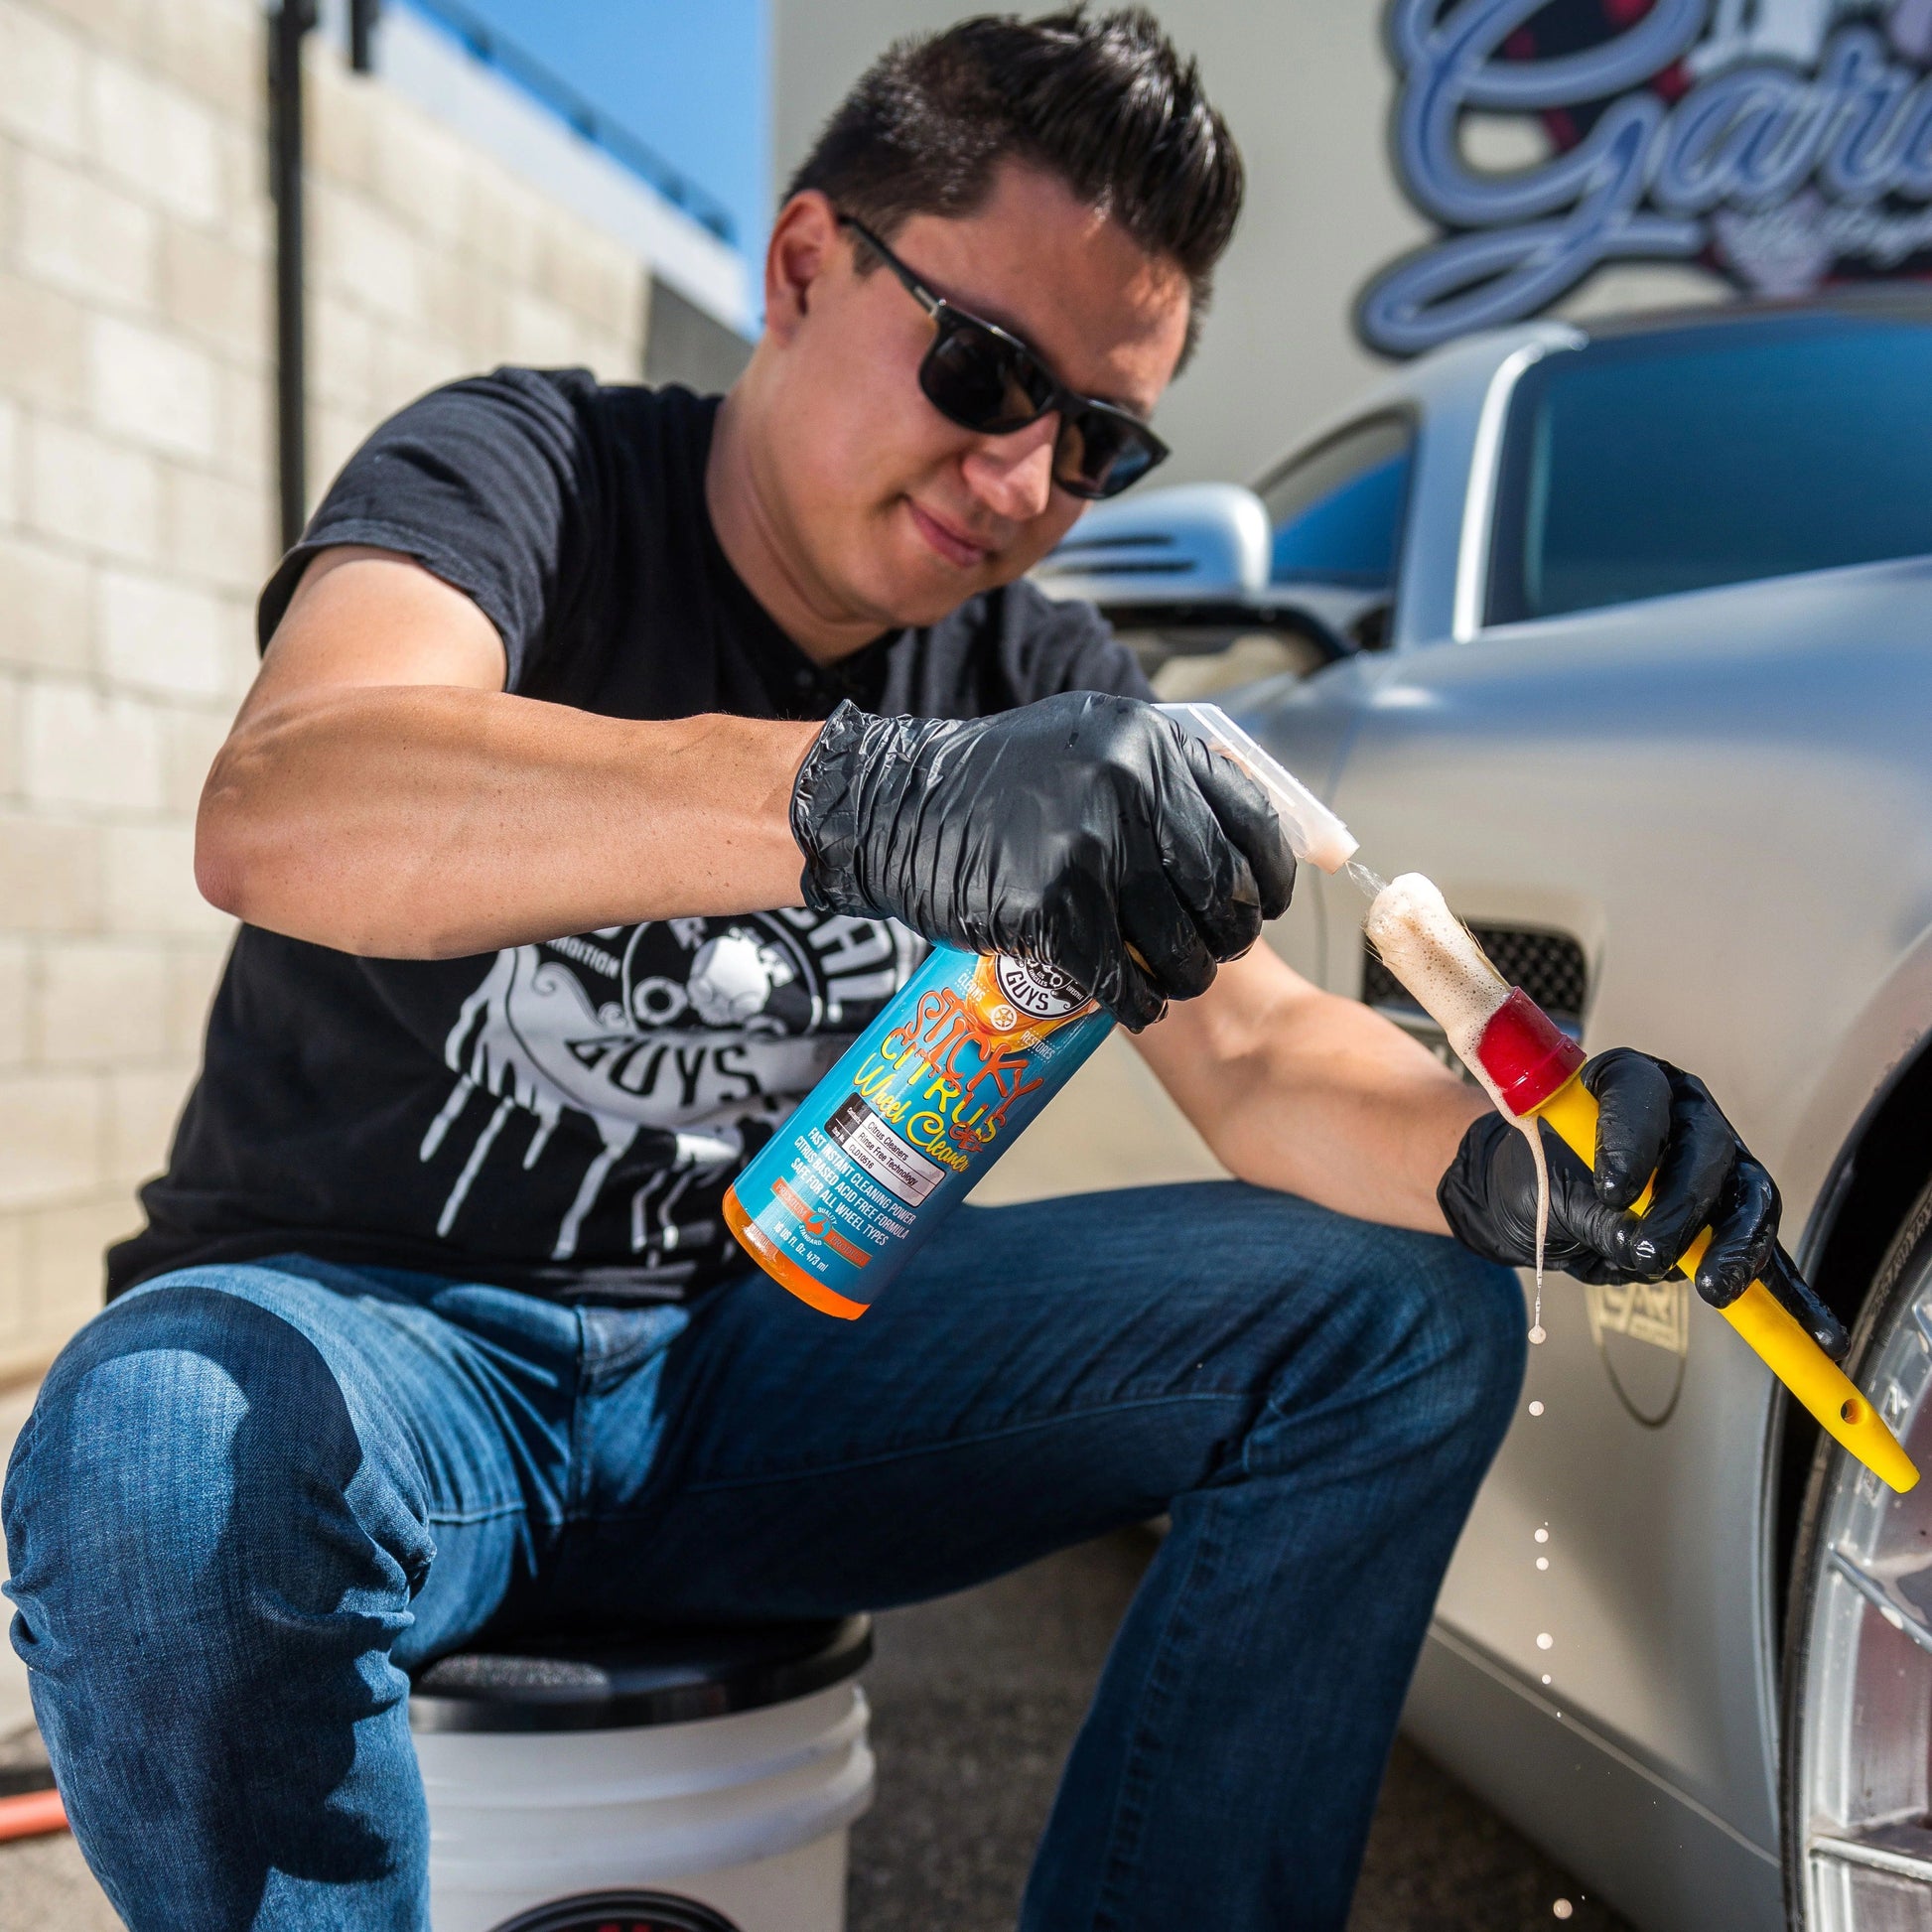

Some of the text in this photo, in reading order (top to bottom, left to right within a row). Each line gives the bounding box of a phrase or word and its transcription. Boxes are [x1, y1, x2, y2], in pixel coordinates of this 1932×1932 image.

[1360, 0, 1932, 343] Gar
[957, 972, 986, 1002] CLEANS
[1006, 970, 1048, 1011] GUYS
[1028, 969, 1048, 987] ANGELES
[1036, 971, 1045, 980] LOS
[905, 987, 1043, 1114] STICKY
[1020, 1030, 1056, 1060] RESTORES
[854, 1052, 970, 1173] Wheel Cleaner
[881, 1029, 1006, 1143] CITRUS
[857, 1132, 874, 1151] Rinse
[874, 1146, 887, 1162] Free
[886, 1157, 918, 1186] Technology
[867, 1121, 885, 1141] Citrus
[884, 1137, 908, 1161] Cleaners
[790, 1158, 890, 1246] SAFE FOR ALL WHEEL TYPES
[794, 1135, 817, 1164] CITRUS
[812, 1157, 839, 1186] BASED
[835, 1181, 858, 1203] ACID
[854, 1197, 879, 1220] FREE
[874, 1212, 909, 1240] FORMULA
[807, 1127, 823, 1149] FAST
[822, 1143, 855, 1177] INSTANT
[850, 1173, 893, 1209] CLEANING
[890, 1202, 916, 1225] POWER
[775, 1183, 867, 1263] PREMIUM PRODUCT
[798, 1224, 822, 1246] STANDARD
[817, 1206, 838, 1225] QUALITY
[773, 1221, 783, 1232] 16
[779, 1229, 792, 1241] US
[795, 1243, 806, 1256] Oz.
[806, 1250, 821, 1266] 473
[816, 1263, 829, 1273] ml
